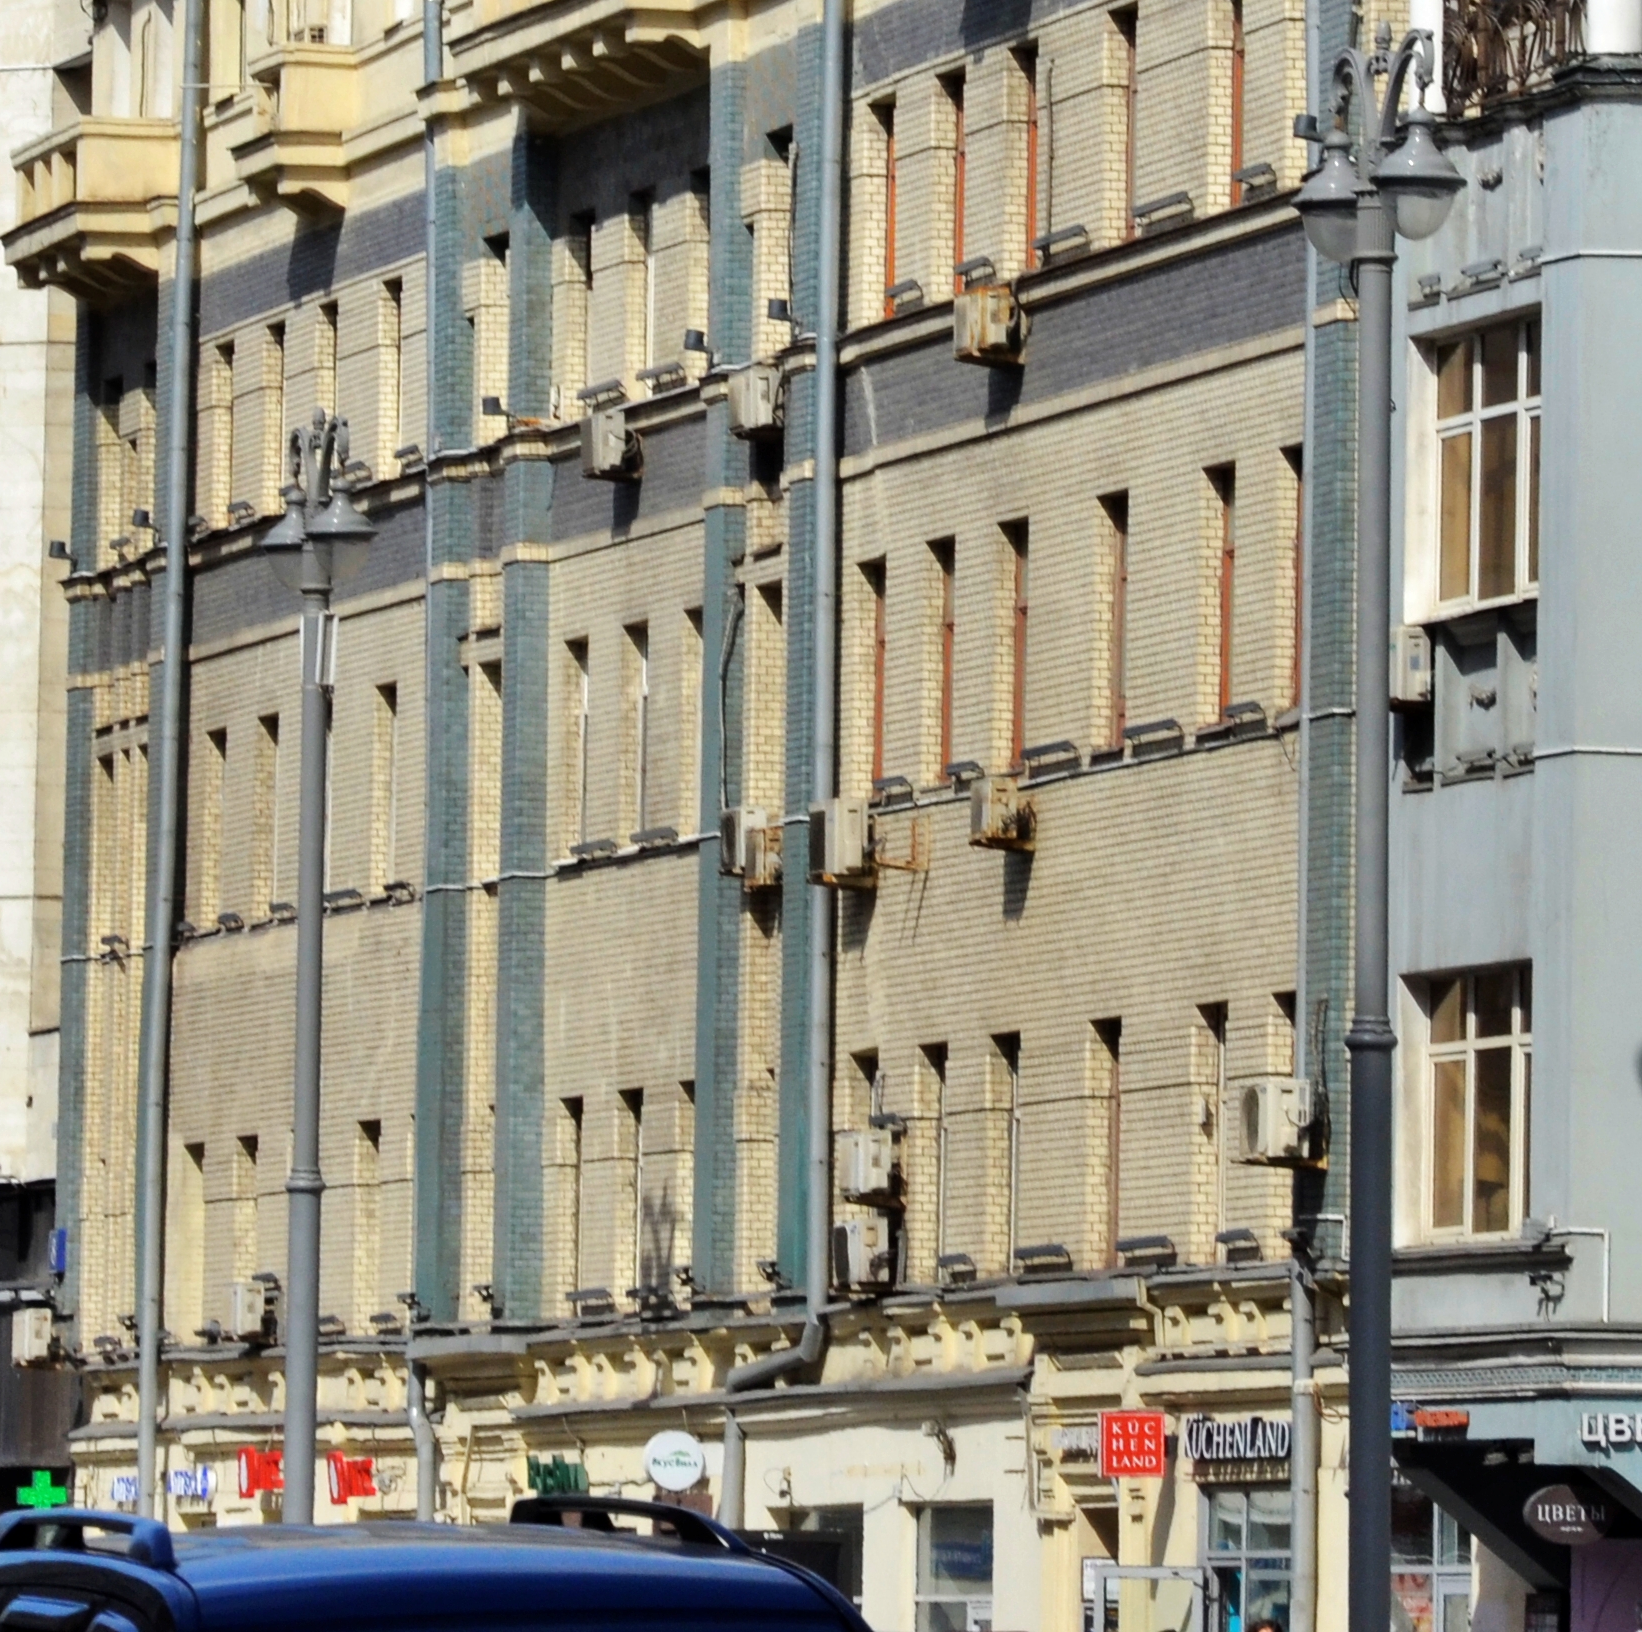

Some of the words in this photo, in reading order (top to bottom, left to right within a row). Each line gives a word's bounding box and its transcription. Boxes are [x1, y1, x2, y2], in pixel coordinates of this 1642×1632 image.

[1184, 1413, 1289, 1460] KÜCHENLAND
[1112, 1455, 1157, 1468] LAND
[1537, 1504, 1605, 1524] ЦВЕТЫ
